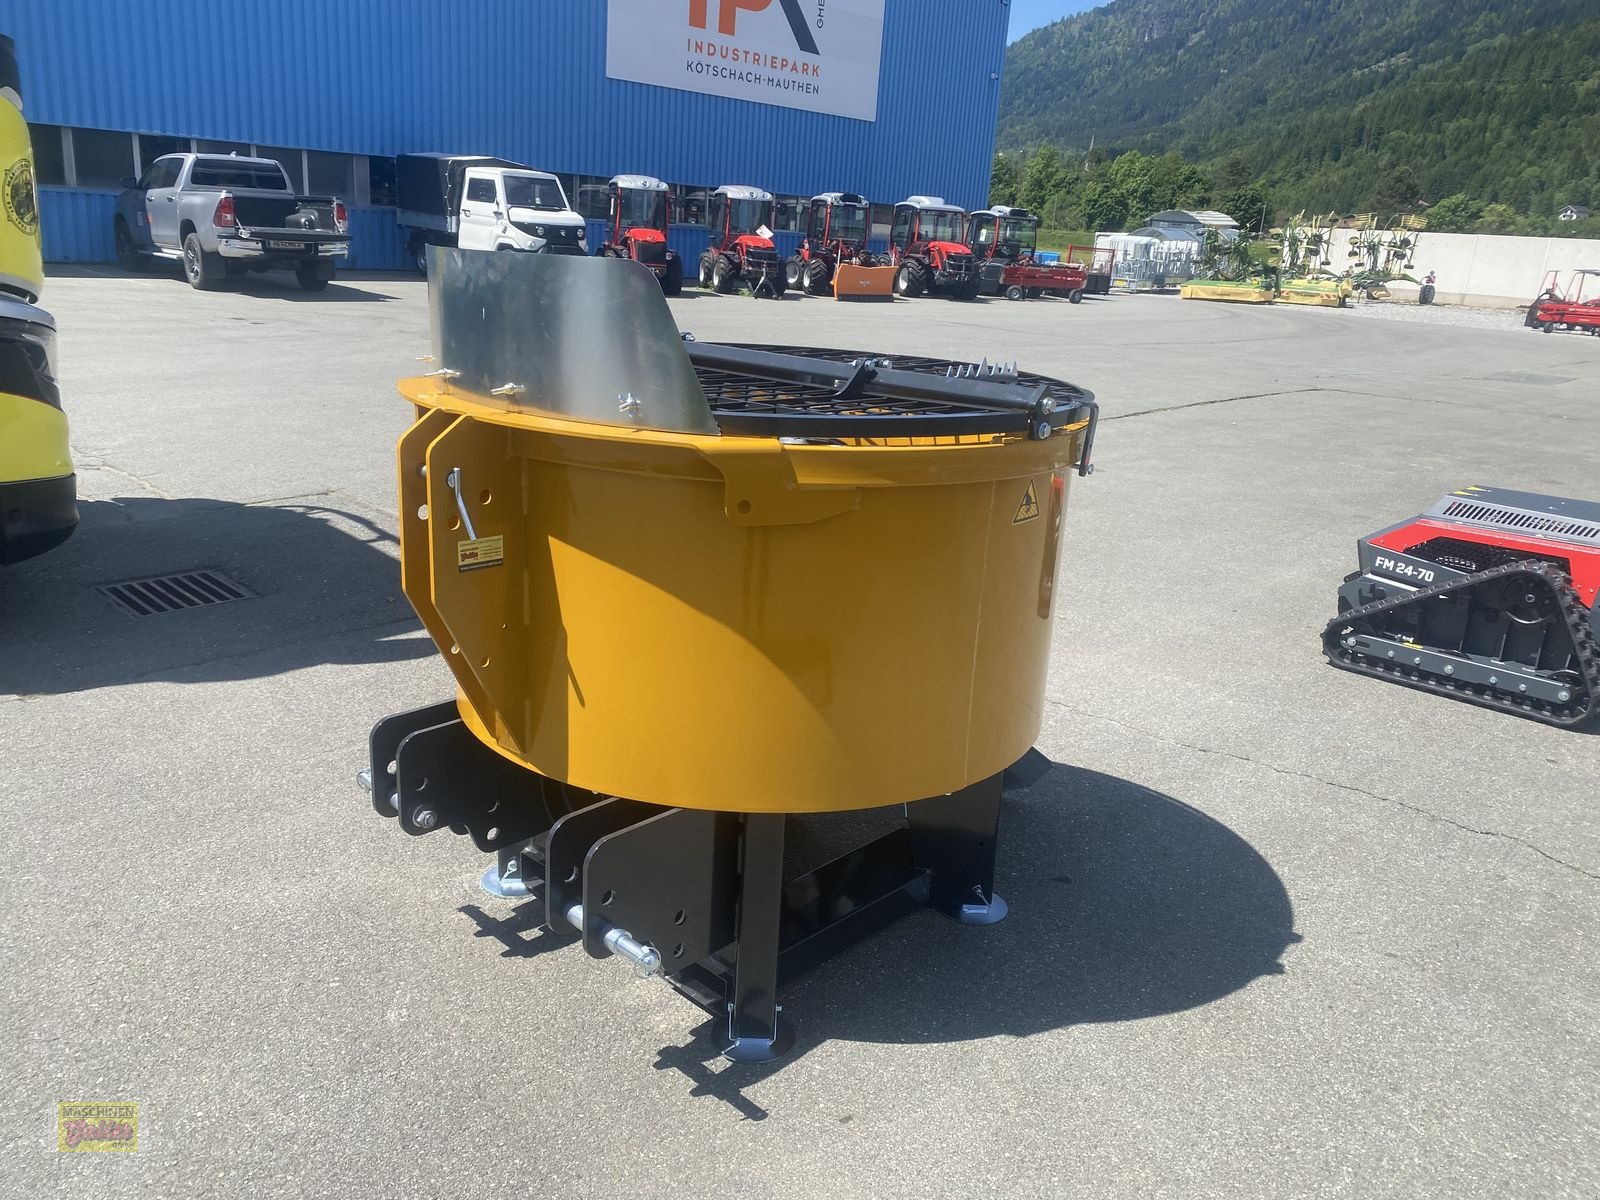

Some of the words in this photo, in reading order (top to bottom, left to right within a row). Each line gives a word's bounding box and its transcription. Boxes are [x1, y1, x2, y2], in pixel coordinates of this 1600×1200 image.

[687, 38, 820, 78] INDUSTRIEPARK
[686, 60, 820, 95] KÖTSCHACH-MAUTHEN
[1375, 556, 1395, 571] FM
[1395, 562, 1435, 582] 24-70
